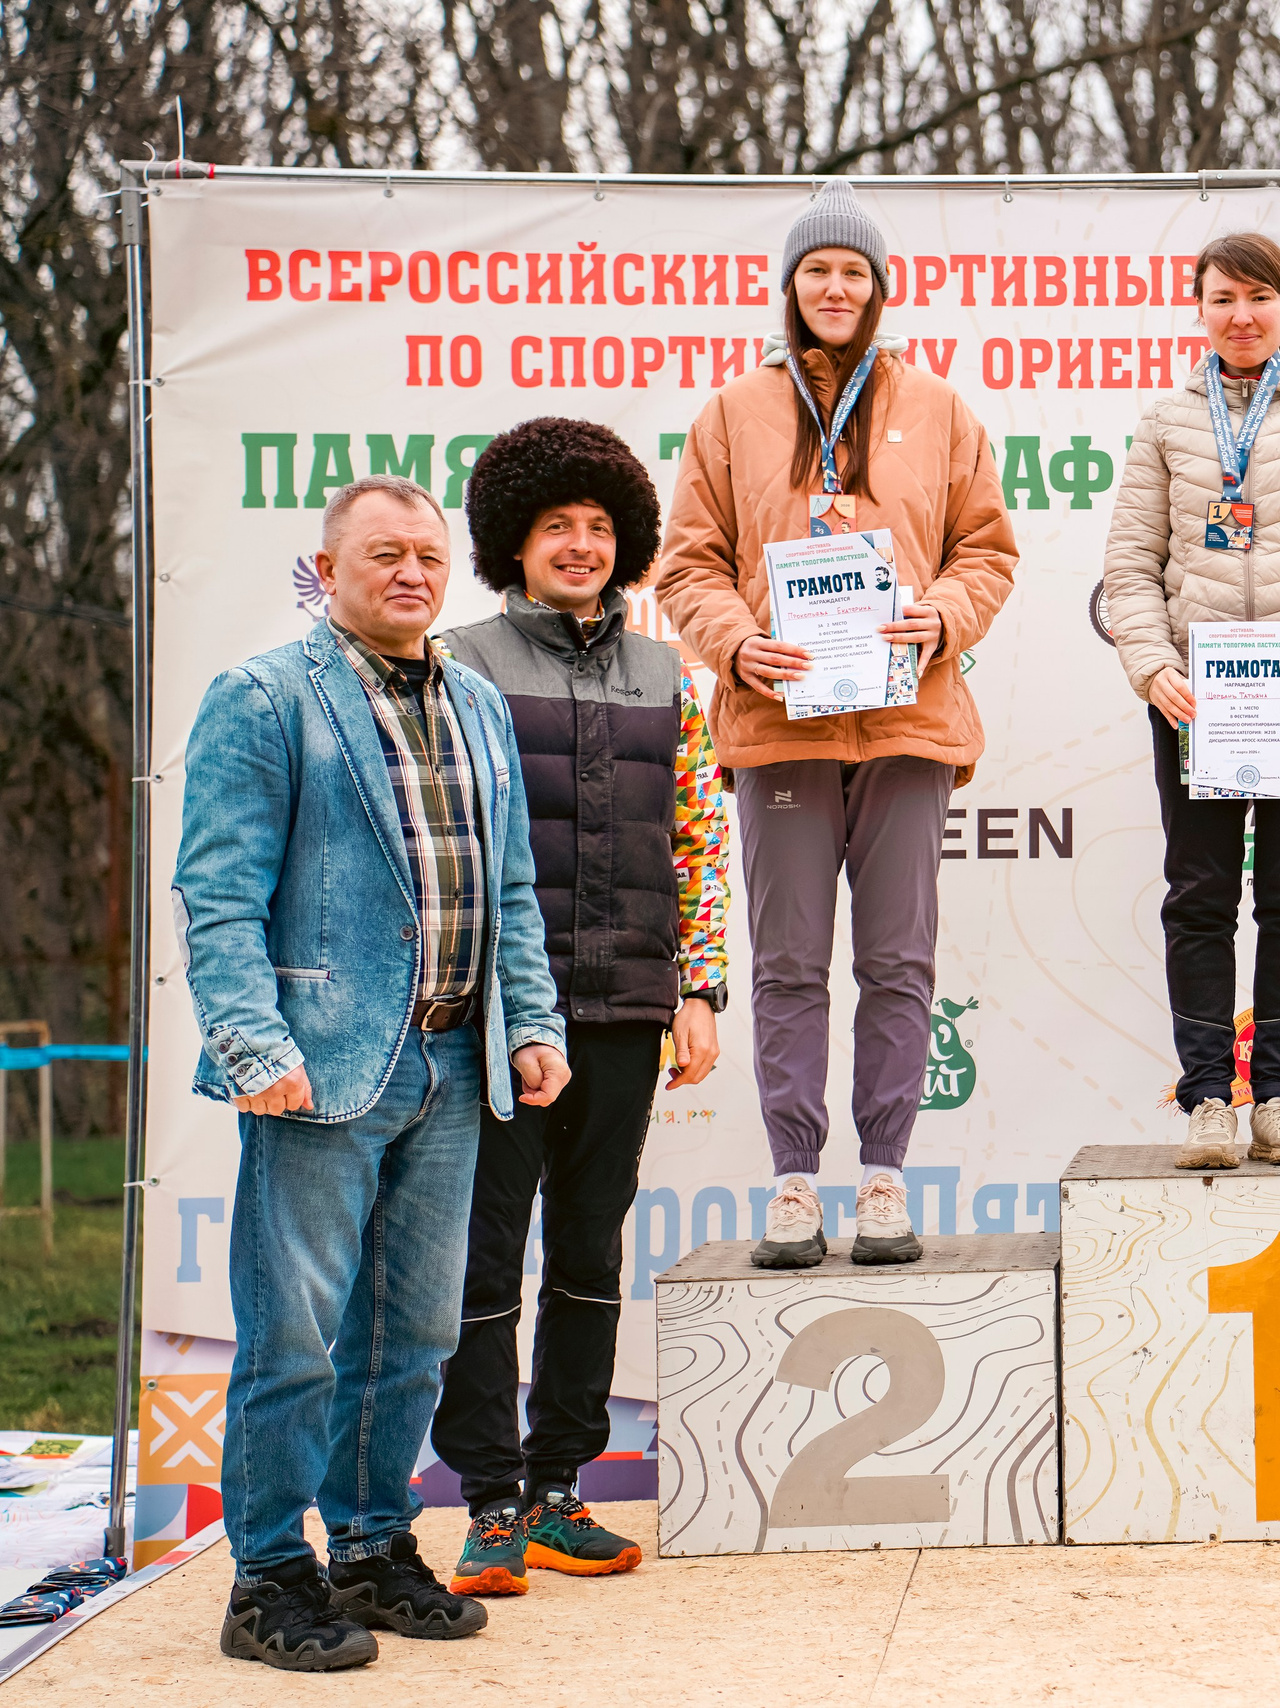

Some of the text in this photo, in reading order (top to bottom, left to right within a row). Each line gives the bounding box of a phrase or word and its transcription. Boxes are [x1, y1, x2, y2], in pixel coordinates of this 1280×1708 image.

[245, 241, 769, 306] ВСЕРОССИЙСКИЕ
[882, 254, 1199, 307] ОРТИВНЫЕ
[405, 335, 483, 387] ПО
[1239, 368, 1273, 443] ВОЕННОГО ТОПОГРАФА
[1251, 395, 1271, 434] ПАСТУХОВА
[1205, 367, 1231, 473] ВСЕРОССИЙСКИЕ СОРЕВНОВАНИЯ
[1213, 504, 1222, 519] 1
[786, 545, 854, 558] СПОРТИВНОГО ОРИЕНТИРОВАНИЯ
[806, 542, 831, 550] ФЕСТИВАЛЬ
[776, 552, 869, 569] ПАМЯТИ ТОПОГРАФА ПАСТУХОВА
[786, 571, 865, 599] ГРАМОТА
[808, 596, 850, 605] НАГРАЖДАЕТСЯ
[797, 634, 873, 647] СПОРТИВНОГО ОРИЕНТИРОВАНИЯ
[768, 1306, 951, 1529] 2
